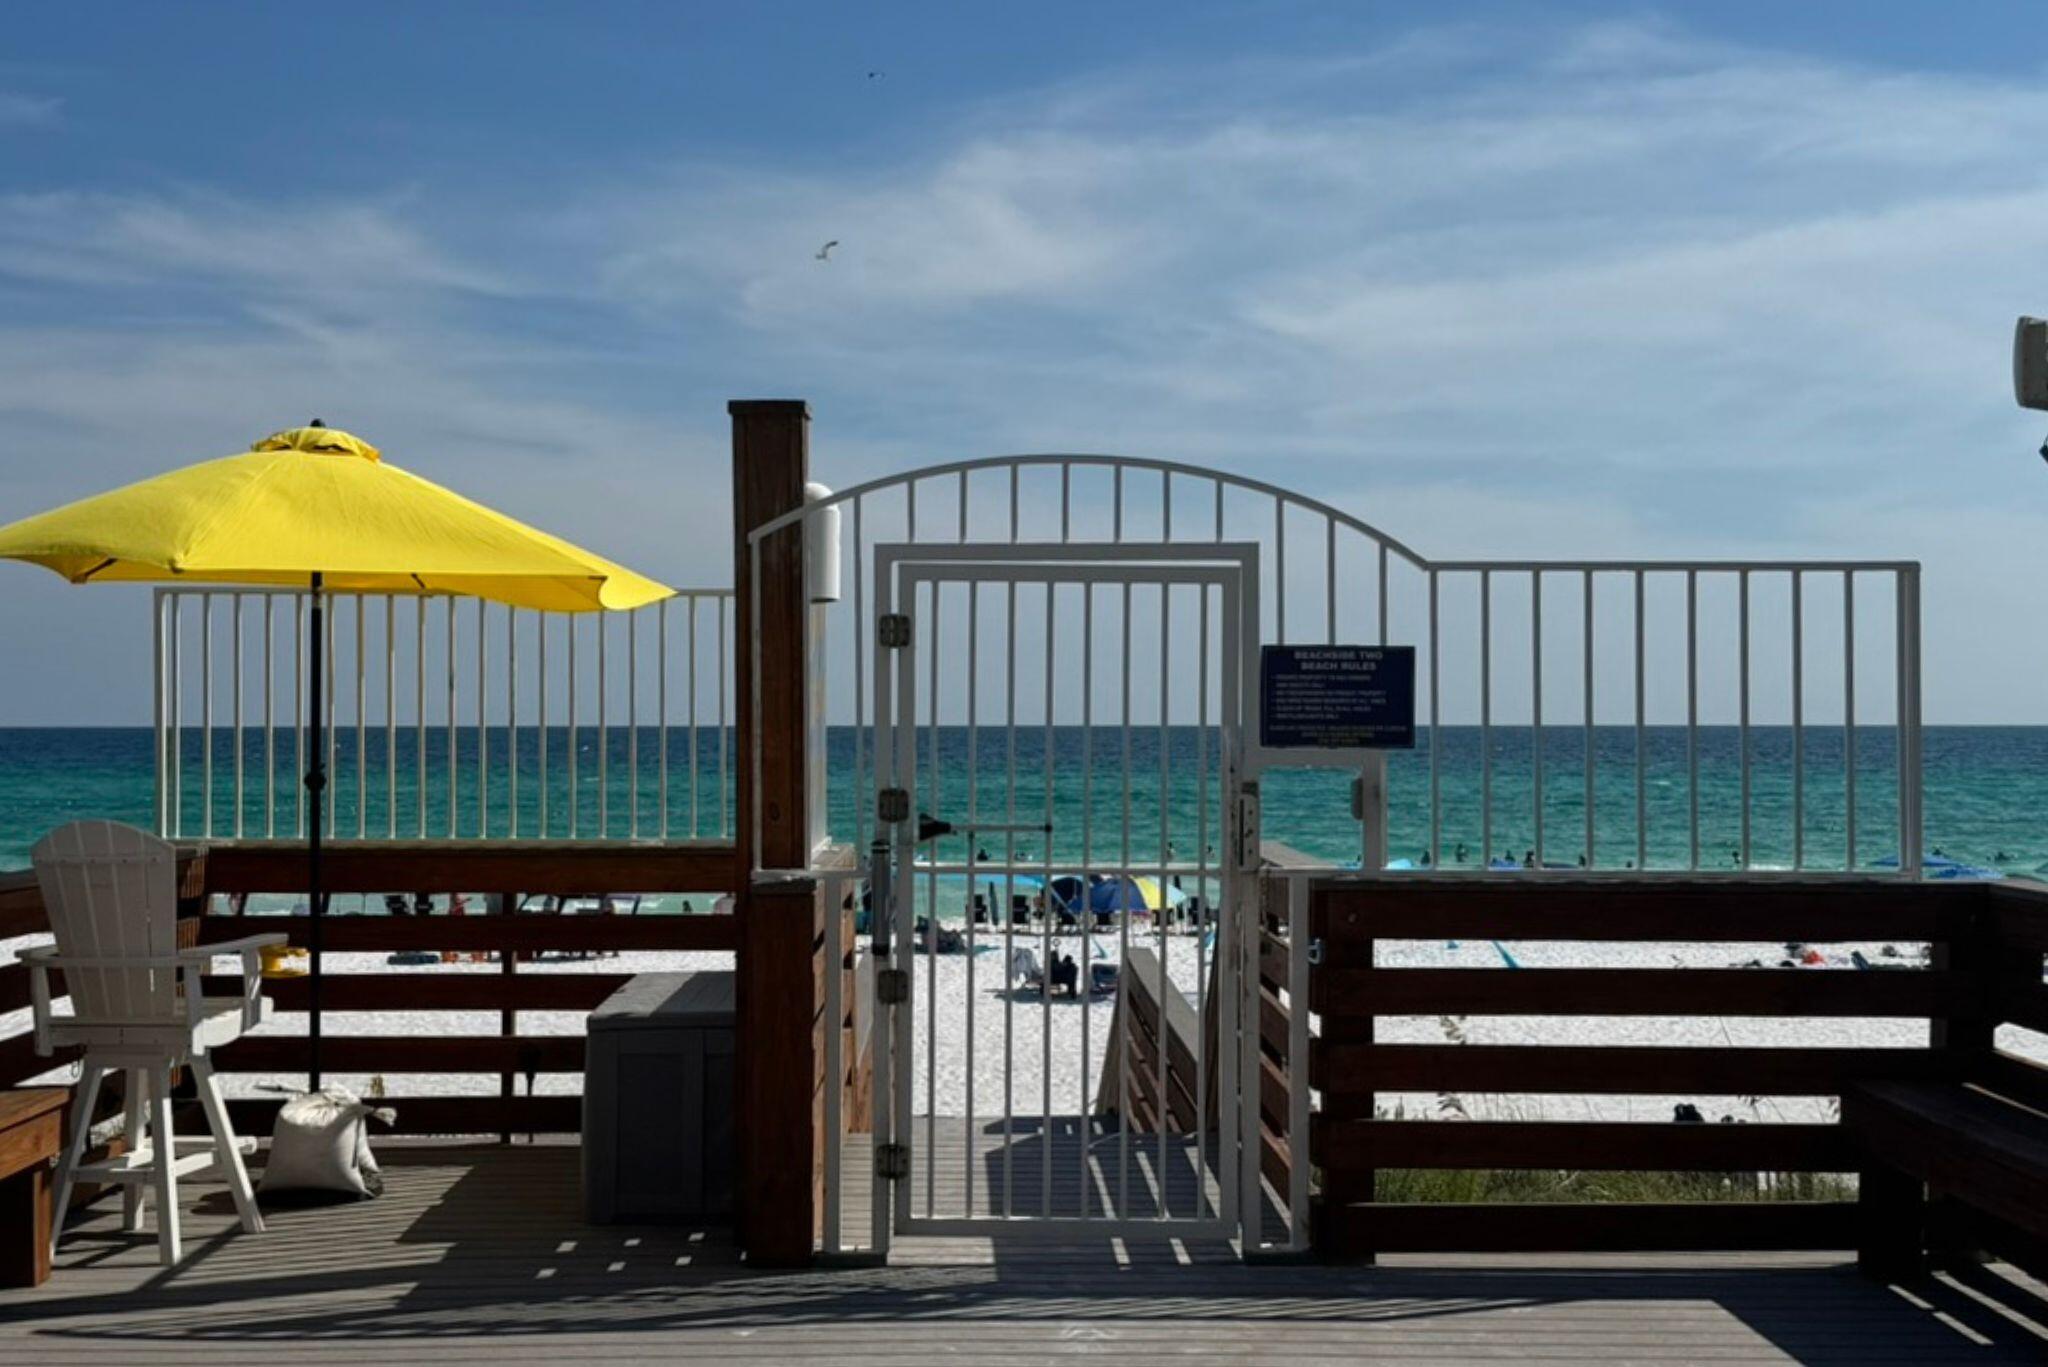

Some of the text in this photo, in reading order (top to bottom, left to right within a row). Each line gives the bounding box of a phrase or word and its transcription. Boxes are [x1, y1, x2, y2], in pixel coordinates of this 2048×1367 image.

[1294, 651, 1383, 660] BEACHSIDE TWO
[1301, 661, 1376, 671] BEACH RULES
